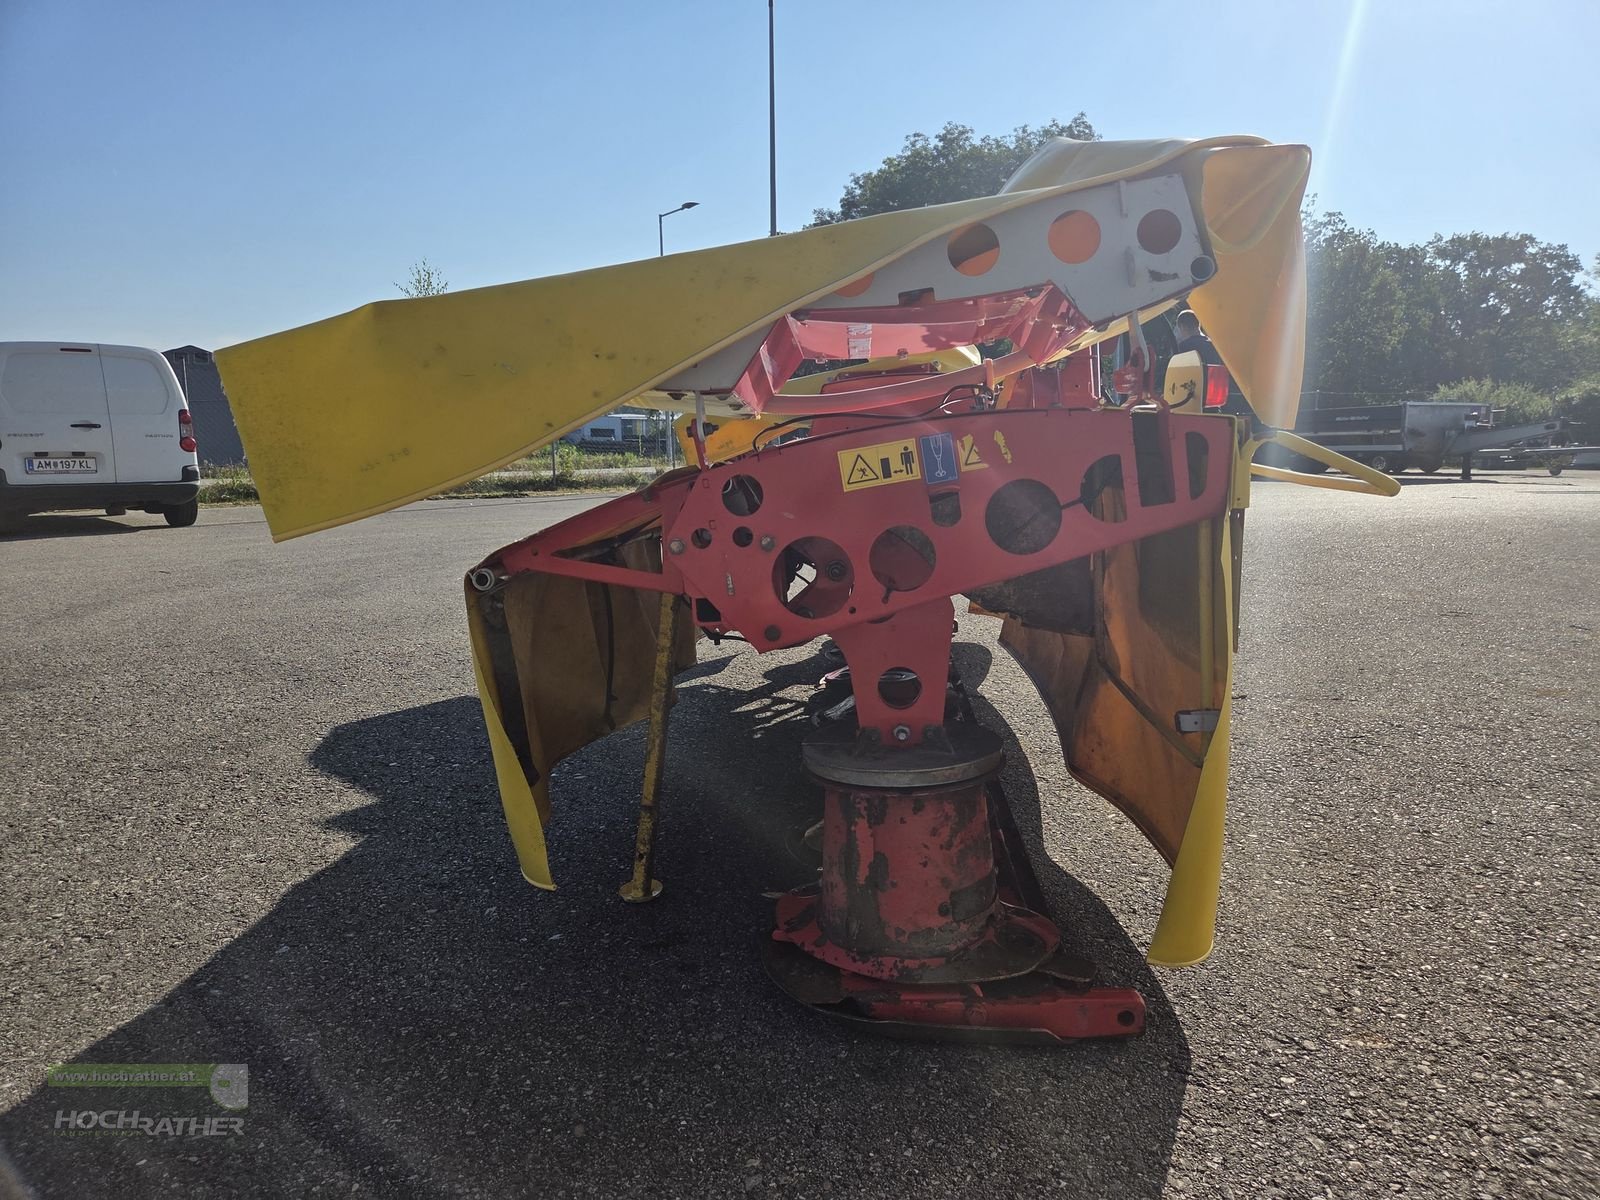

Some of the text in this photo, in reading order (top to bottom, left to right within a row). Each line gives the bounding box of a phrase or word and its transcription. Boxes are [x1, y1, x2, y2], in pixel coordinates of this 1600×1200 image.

[37, 460, 91, 469] AM 197 KL
